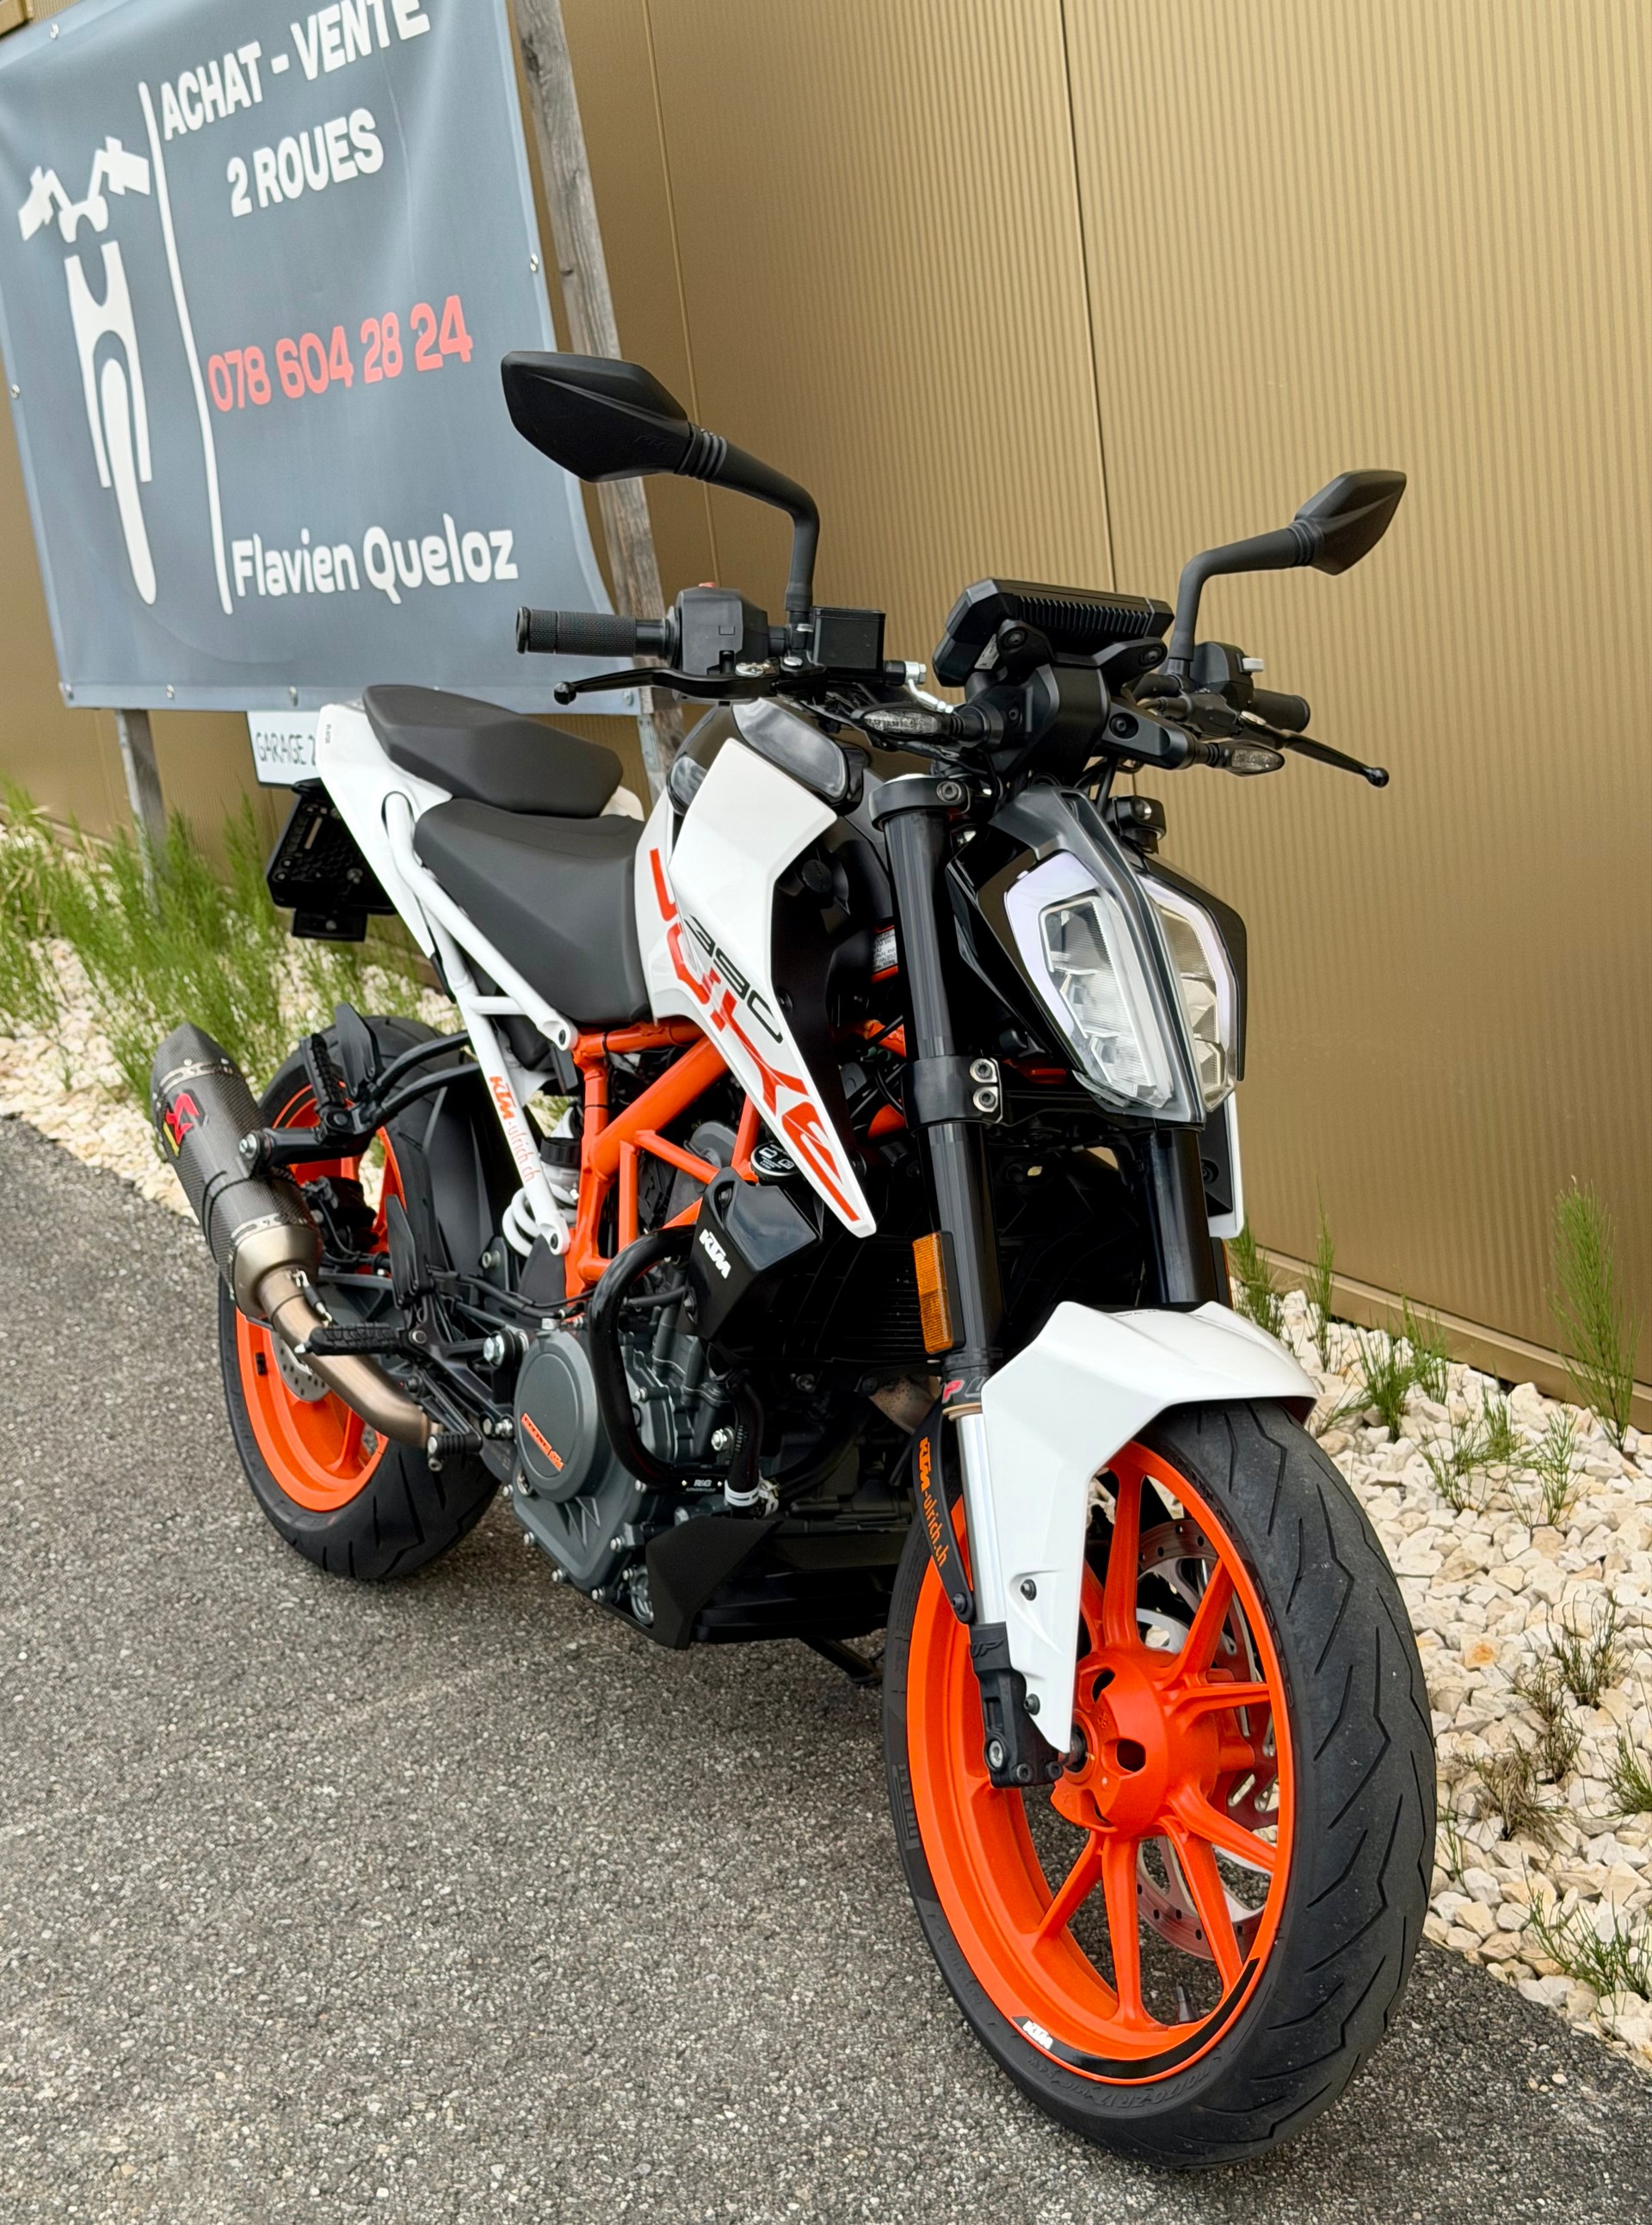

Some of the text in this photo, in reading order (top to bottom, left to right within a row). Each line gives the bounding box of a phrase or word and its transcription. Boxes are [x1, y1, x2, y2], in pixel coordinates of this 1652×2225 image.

[161, 0, 431, 141] ACHAT - VENTE
[227, 108, 384, 217] 2 ROUES
[208, 295, 472, 411] 078 604 28 24
[231, 514, 518, 604] Flavien Queloz
[256, 731, 306, 765] GARAGE
[699, 1228, 731, 1279] KTM
[1022, 2020, 1053, 2049] KTM
